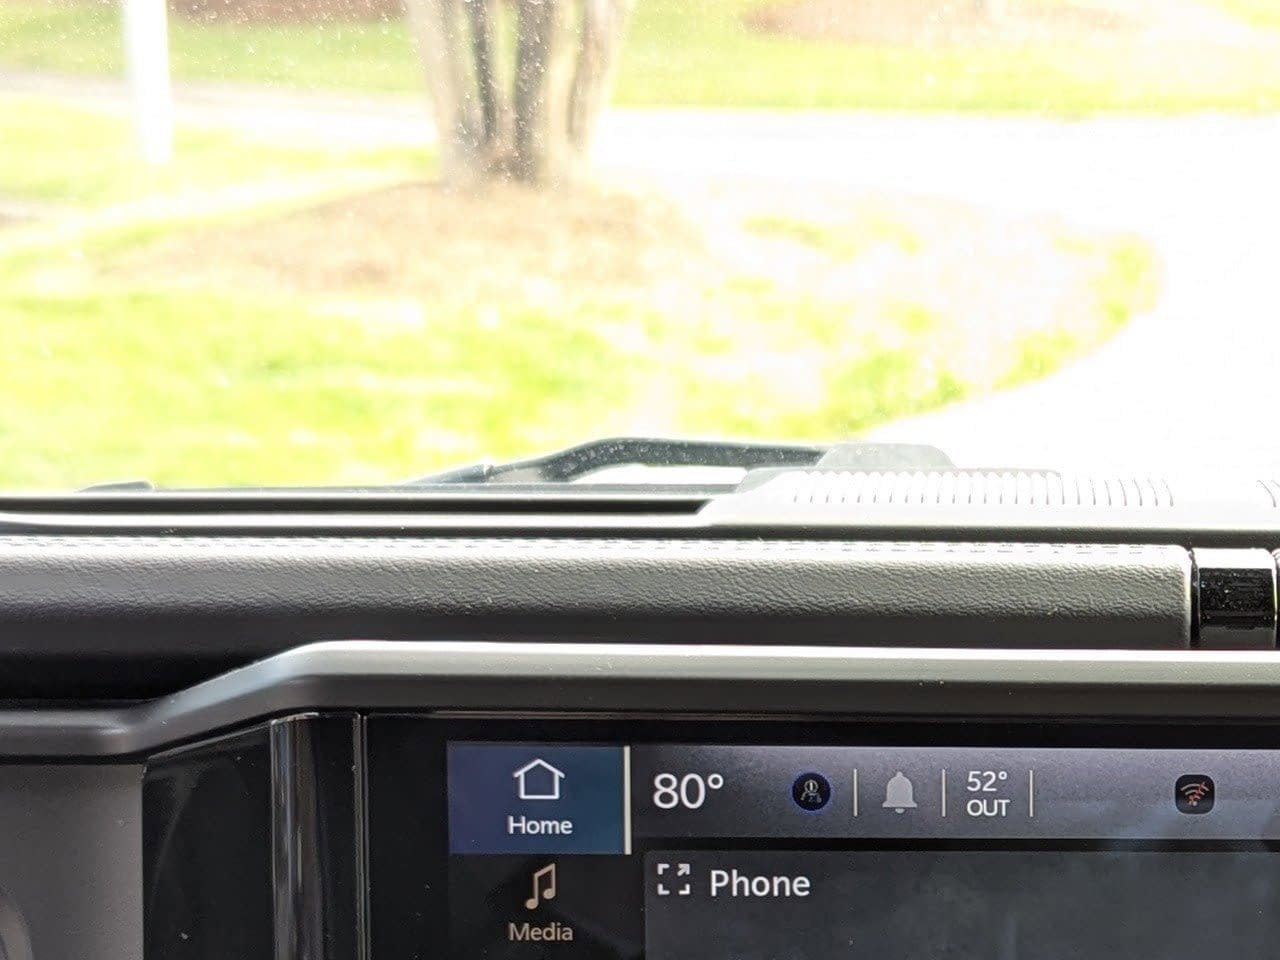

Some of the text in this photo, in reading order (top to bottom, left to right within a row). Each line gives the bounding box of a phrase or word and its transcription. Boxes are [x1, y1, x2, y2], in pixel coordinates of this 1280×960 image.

[653, 773, 724, 809] 80°
[967, 771, 1007, 793] 52°
[967, 799, 1010, 817] OUT
[508, 816, 573, 835] Home
[710, 871, 810, 896] Phone
[509, 923, 573, 941] Media
